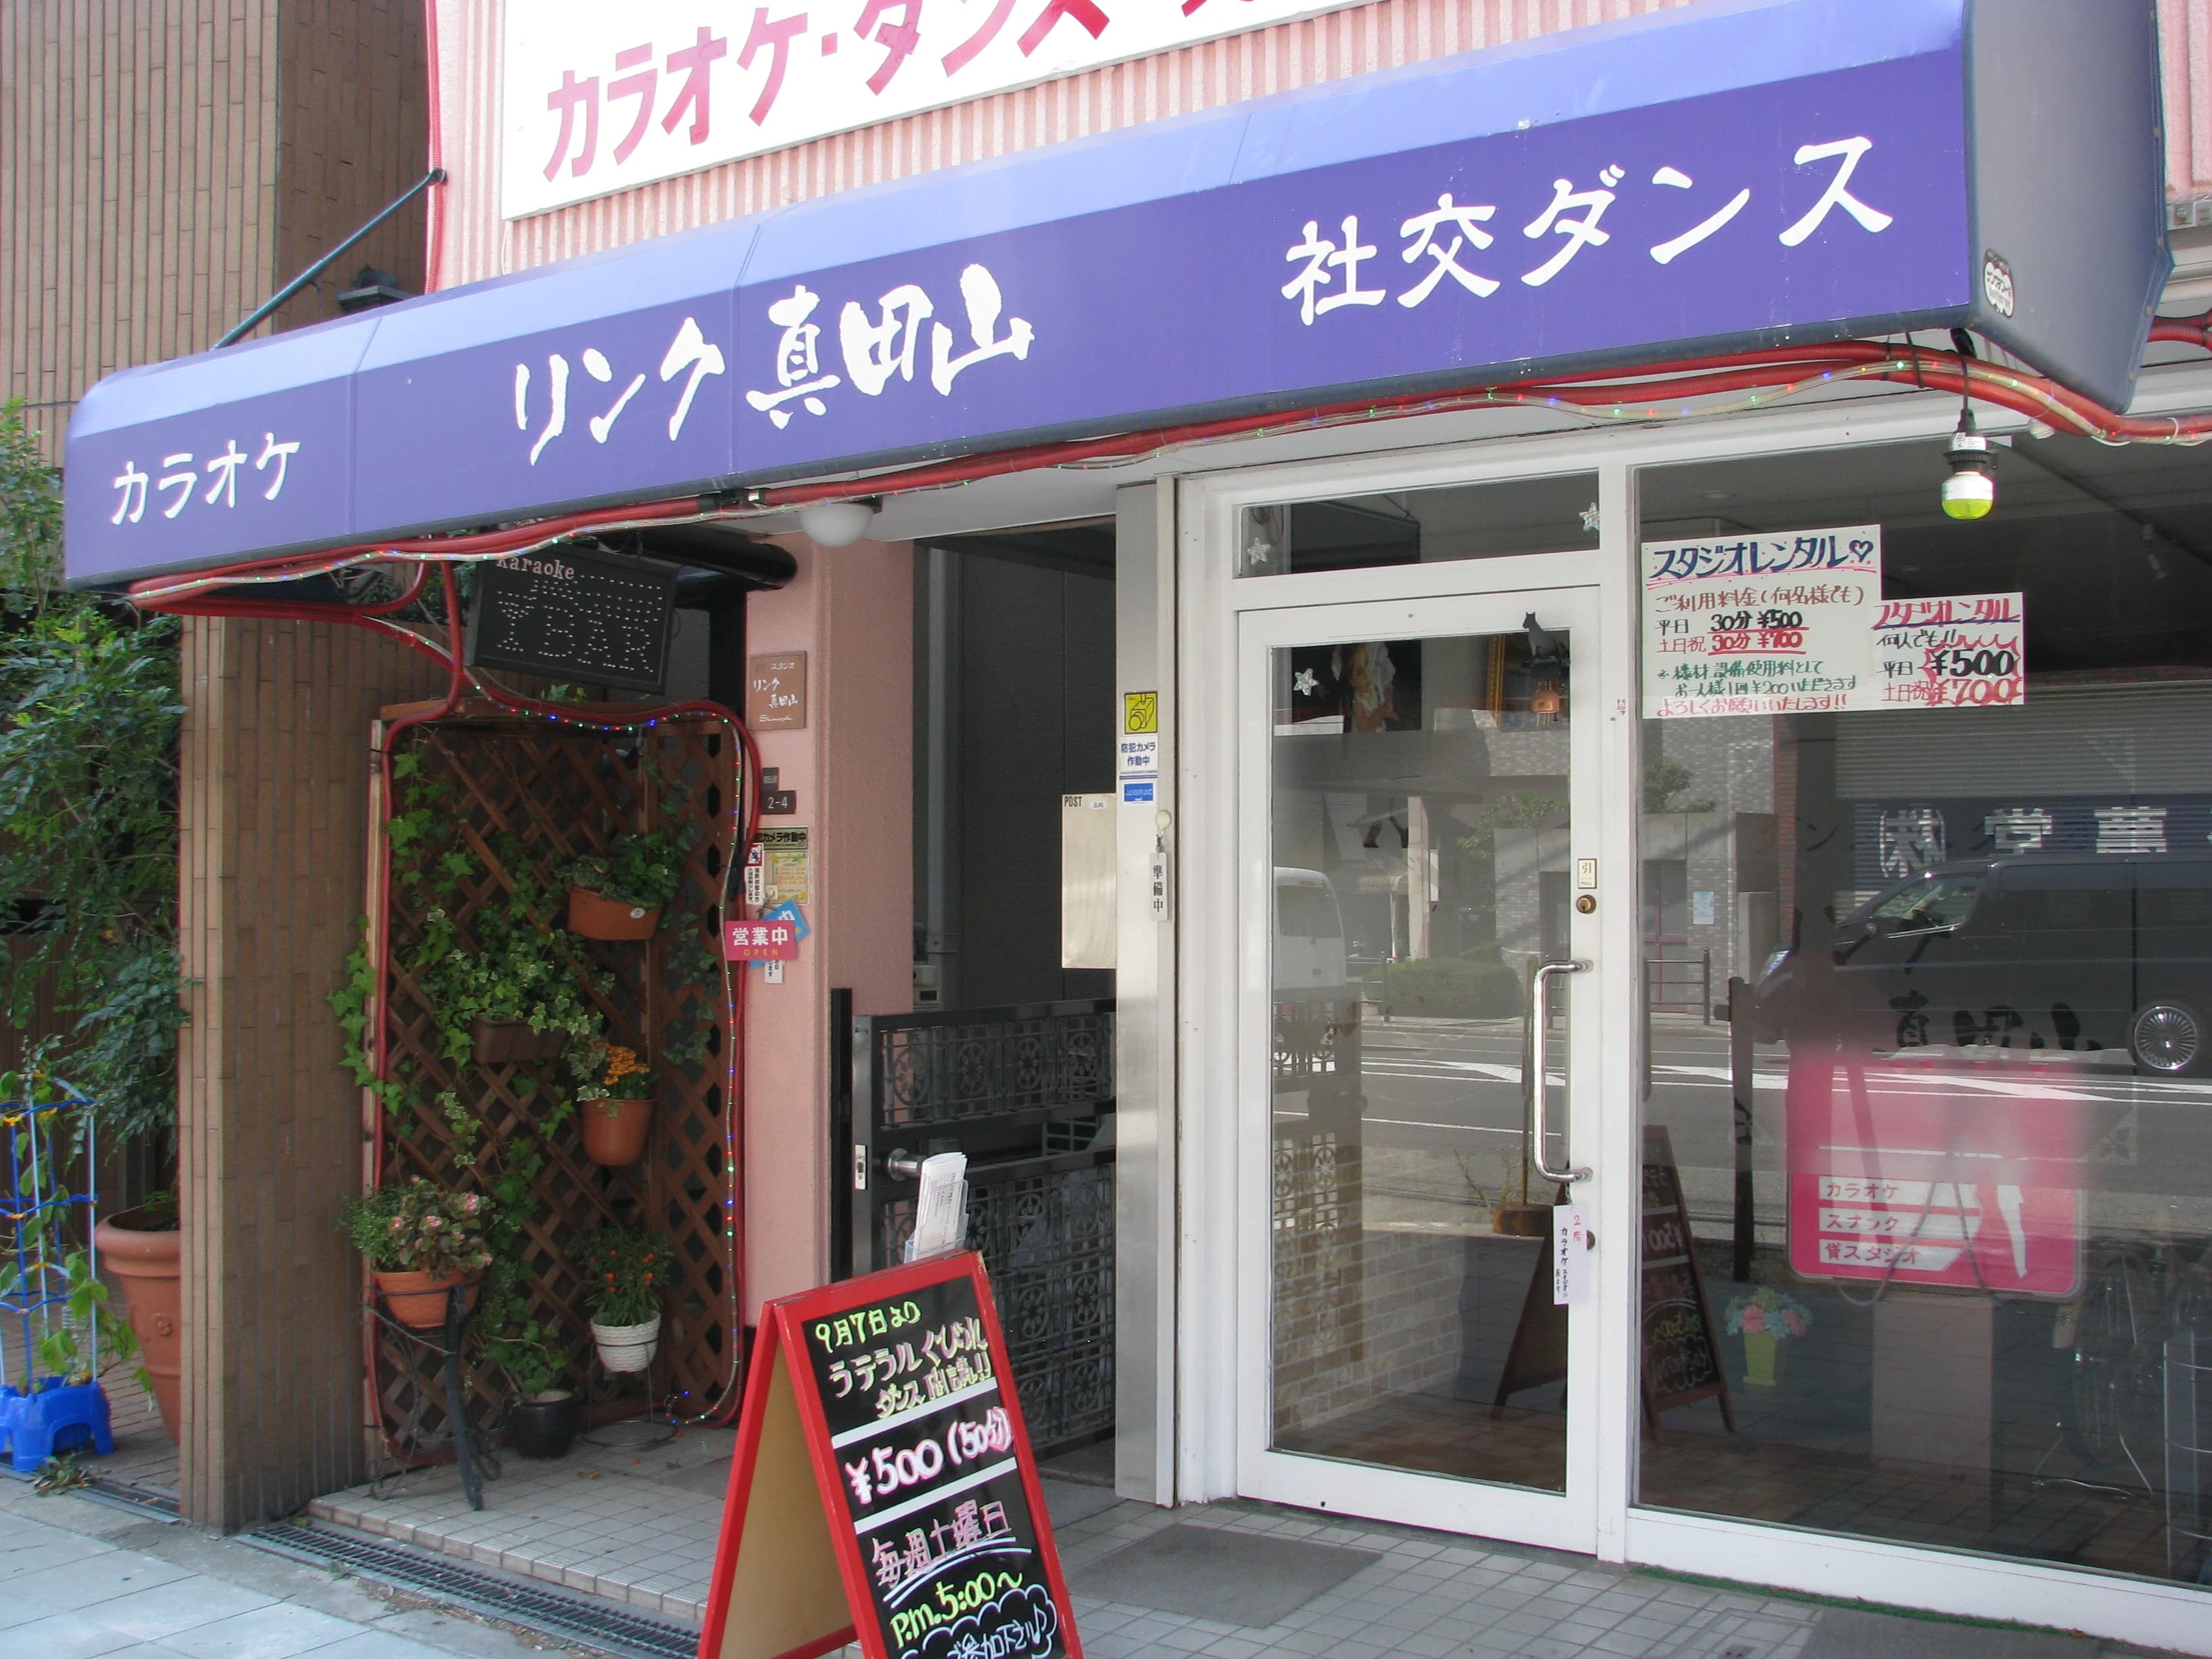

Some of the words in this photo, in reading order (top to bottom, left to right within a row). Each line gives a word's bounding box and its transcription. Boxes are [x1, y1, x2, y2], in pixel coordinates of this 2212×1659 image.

[1282, 136, 1893, 326] 社交ダンス
[110, 432, 300, 525] カラオケ
[497, 556, 575, 580] Karaoke
[1655, 619, 1689, 636] 平日
[1657, 636, 1706, 654] 土日祝
[1877, 661, 1912, 678] 平日
[1931, 649, 2015, 676] ¥500
[1121, 742, 1155, 753] 防犯カメラ
[1128, 756, 1149, 766] 作動中
[768, 796, 787, 808] 2-4
[1064, 796, 1082, 807] POST
[1582, 862, 1591, 873] 引
[1153, 865, 1164, 913] 準備中
[733, 927, 788, 946] 営業中
[1827, 1182, 1898, 1199] カラオケ
[1827, 1214, 1899, 1231] スナック
[872, 1498, 1012, 1588] 毎週土曜日
